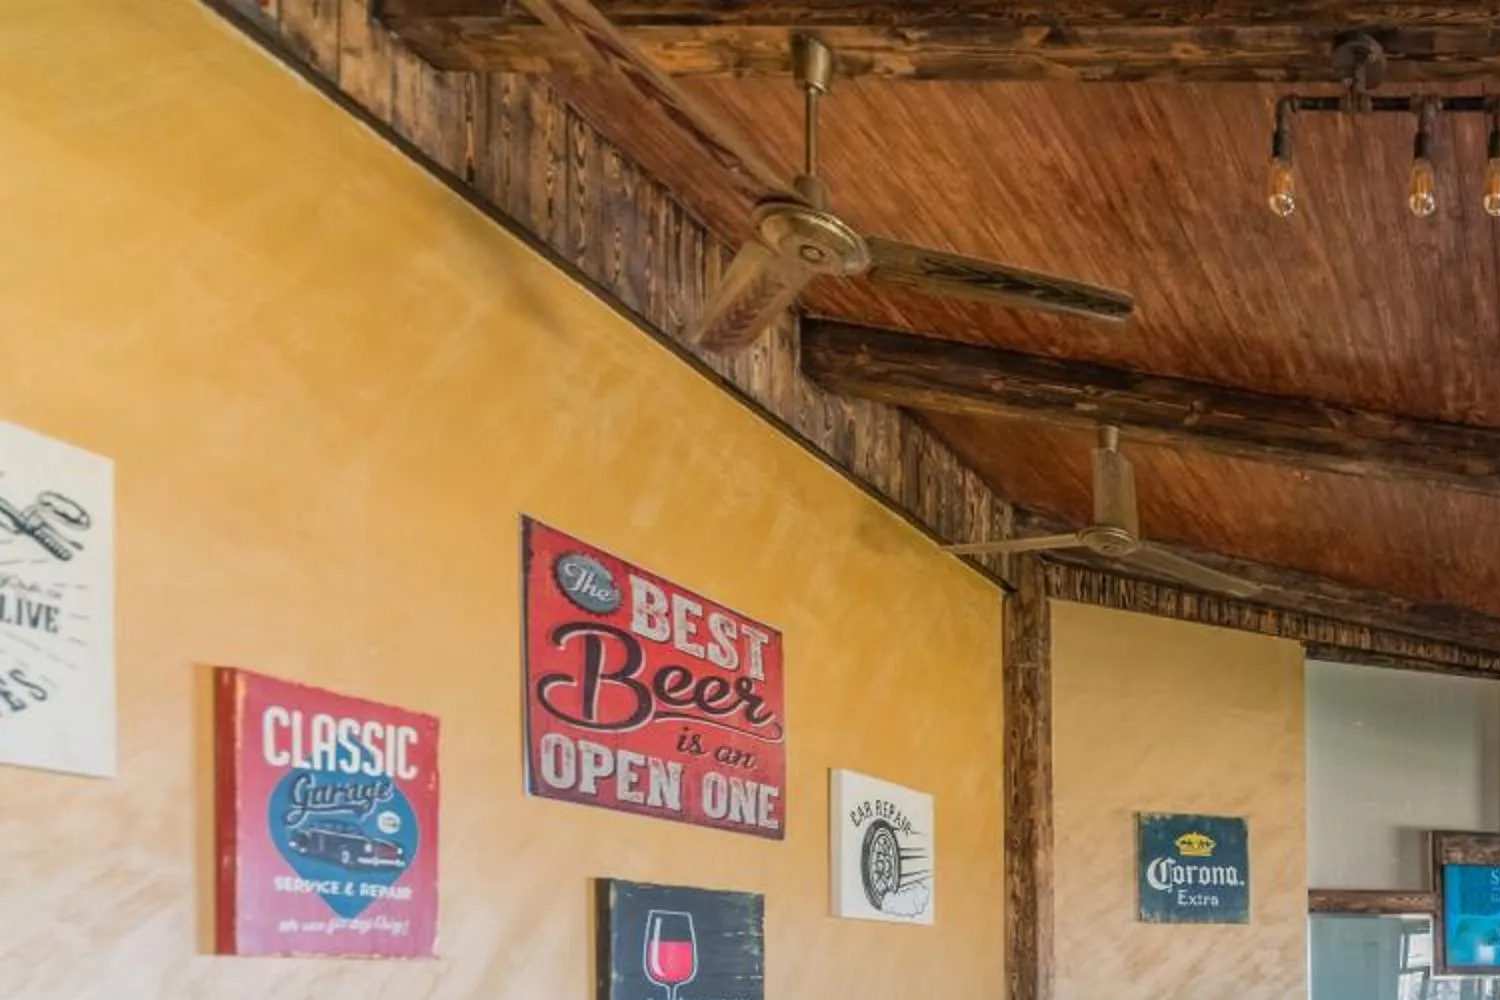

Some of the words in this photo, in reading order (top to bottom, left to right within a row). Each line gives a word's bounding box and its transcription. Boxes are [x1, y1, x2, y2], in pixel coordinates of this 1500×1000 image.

[564, 562, 612, 603] The
[628, 573, 769, 681] BEST
[536, 621, 782, 742] Beer
[262, 704, 419, 780] CLASSIC
[676, 725, 706, 756] is
[713, 744, 758, 769] an
[540, 733, 684, 811] OPEN
[702, 771, 780, 829] ONE
[850, 800, 873, 828] CAR
[273, 875, 341, 897] SERVICE
[358, 880, 413, 900] REPAIR
[1146, 856, 1241, 893] Corona
[1177, 889, 1219, 907] Extra
